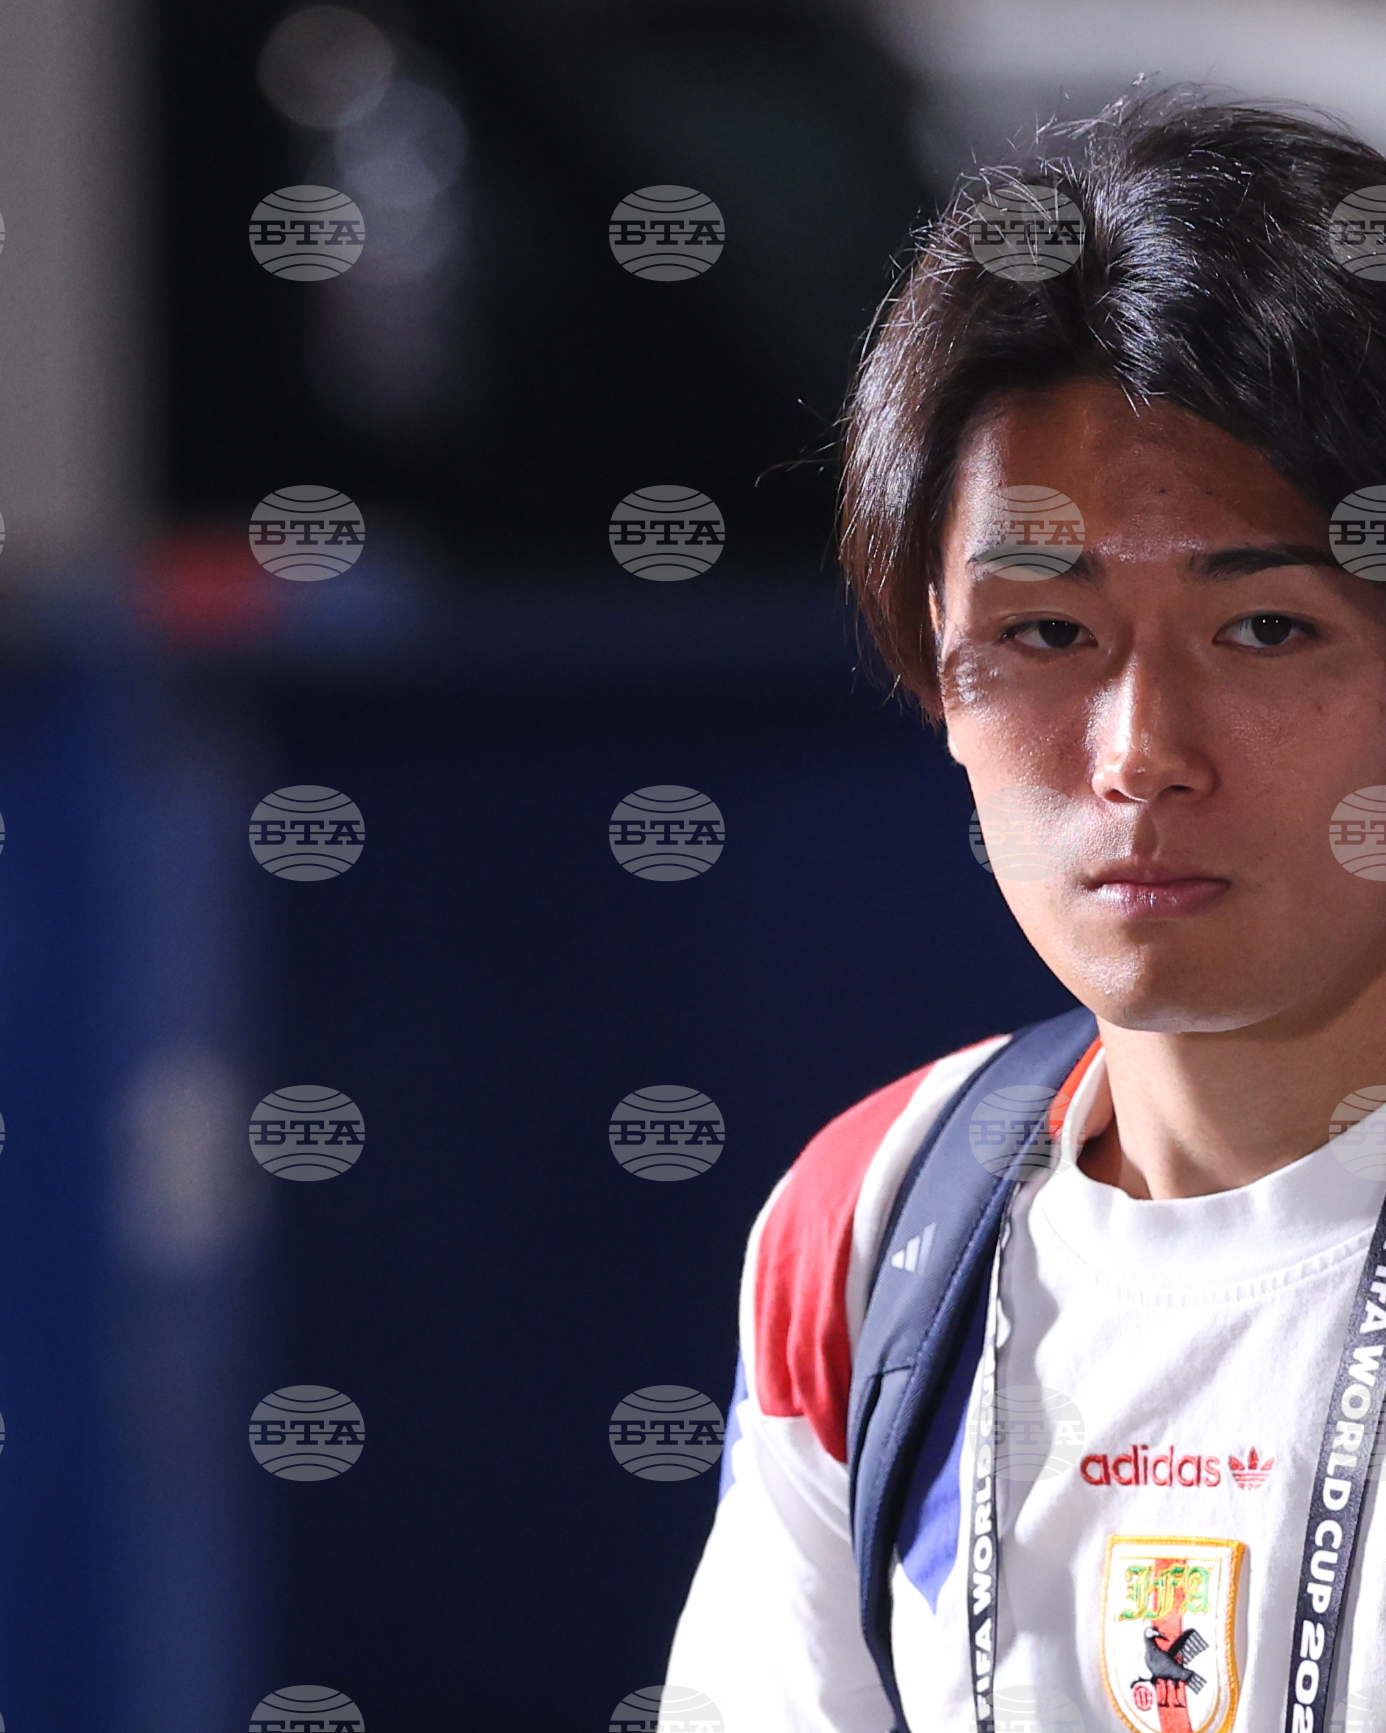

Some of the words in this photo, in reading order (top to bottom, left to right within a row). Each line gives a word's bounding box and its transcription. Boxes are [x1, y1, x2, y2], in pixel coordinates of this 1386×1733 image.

[1080, 1444, 1221, 1487] adidas
[1322, 1345, 1384, 1511] WORLD
[973, 1444, 992, 1616] WORLD
[1306, 1519, 1343, 1614] CUP
[975, 1618, 992, 1720] FIFA
